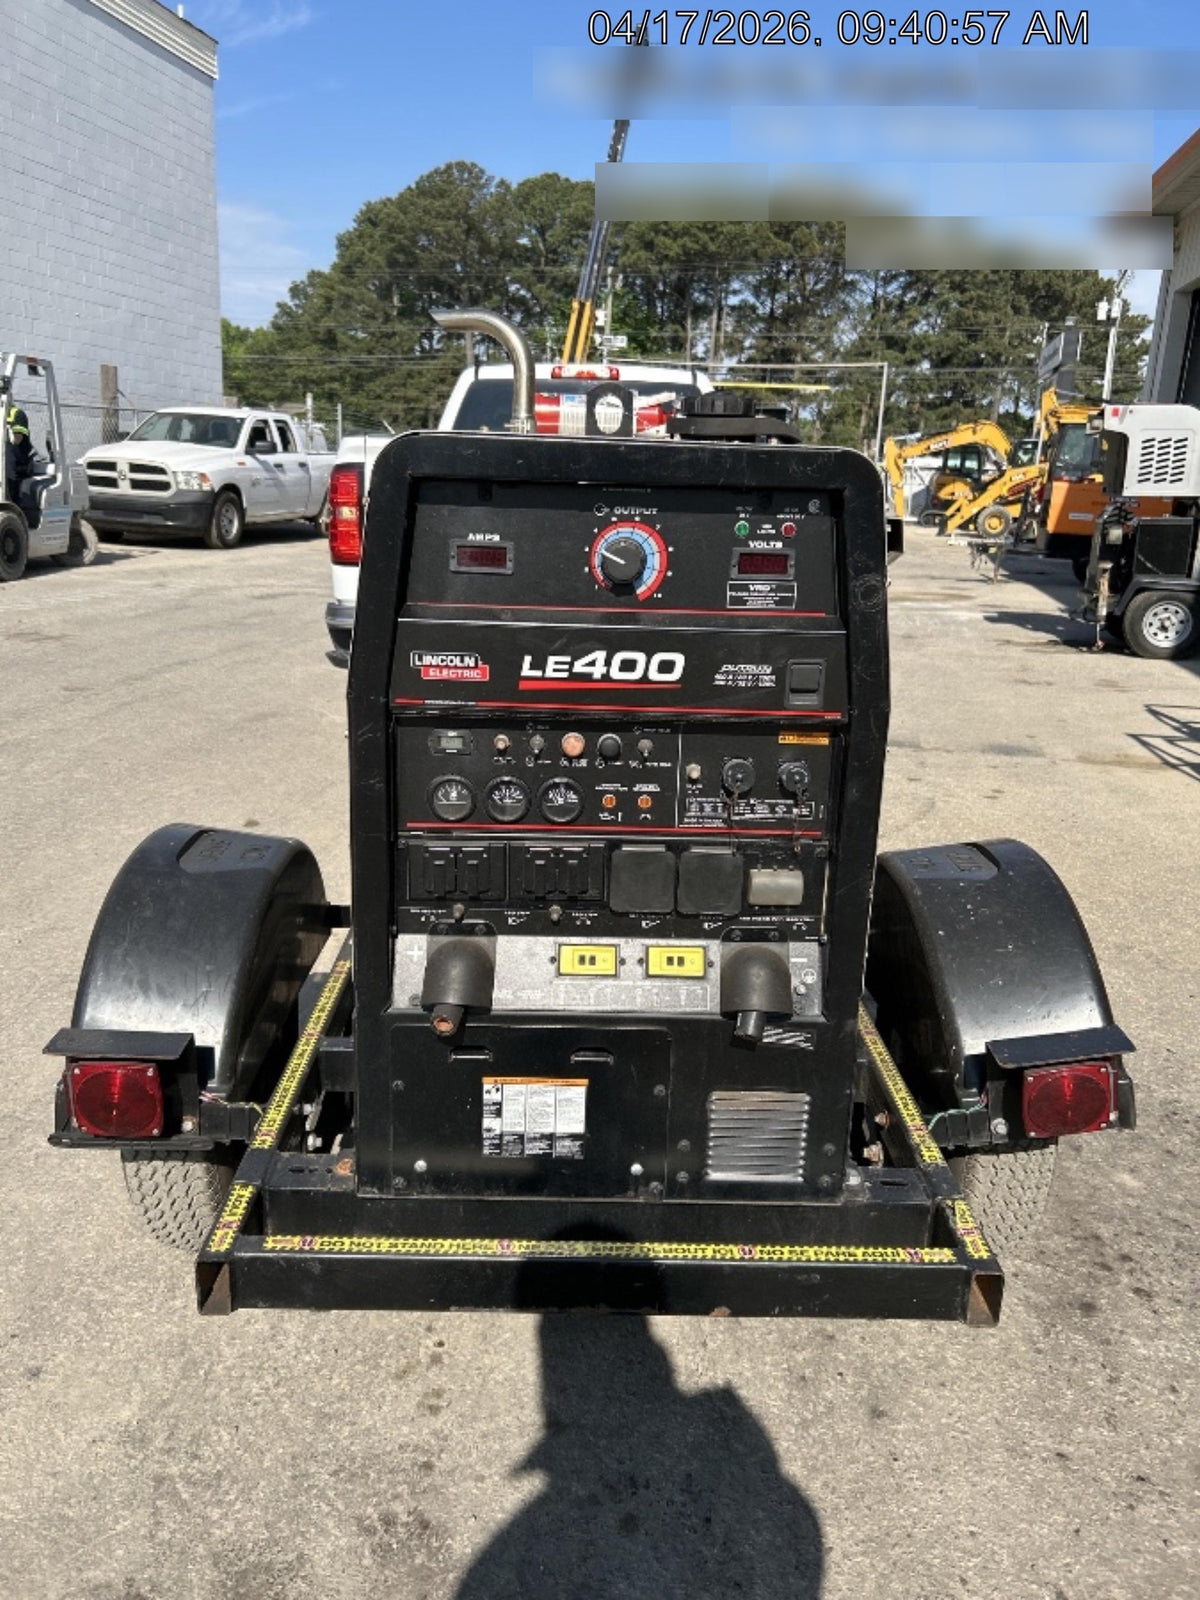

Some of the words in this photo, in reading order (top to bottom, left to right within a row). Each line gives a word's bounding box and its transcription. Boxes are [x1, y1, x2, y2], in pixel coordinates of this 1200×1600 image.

[467, 533, 501, 542] AMPS
[748, 540, 784, 549] VOLTS
[414, 653, 476, 668] LINCOLN
[520, 649, 686, 683] LE400
[428, 667, 483, 679] ELECTRIC
[319, 1240, 345, 1248] DO
[349, 1240, 384, 1249] NOT
[388, 1241, 445, 1250] STAND
[759, 1247, 784, 1256] NO
[814, 1250, 857, 1258] PARE
